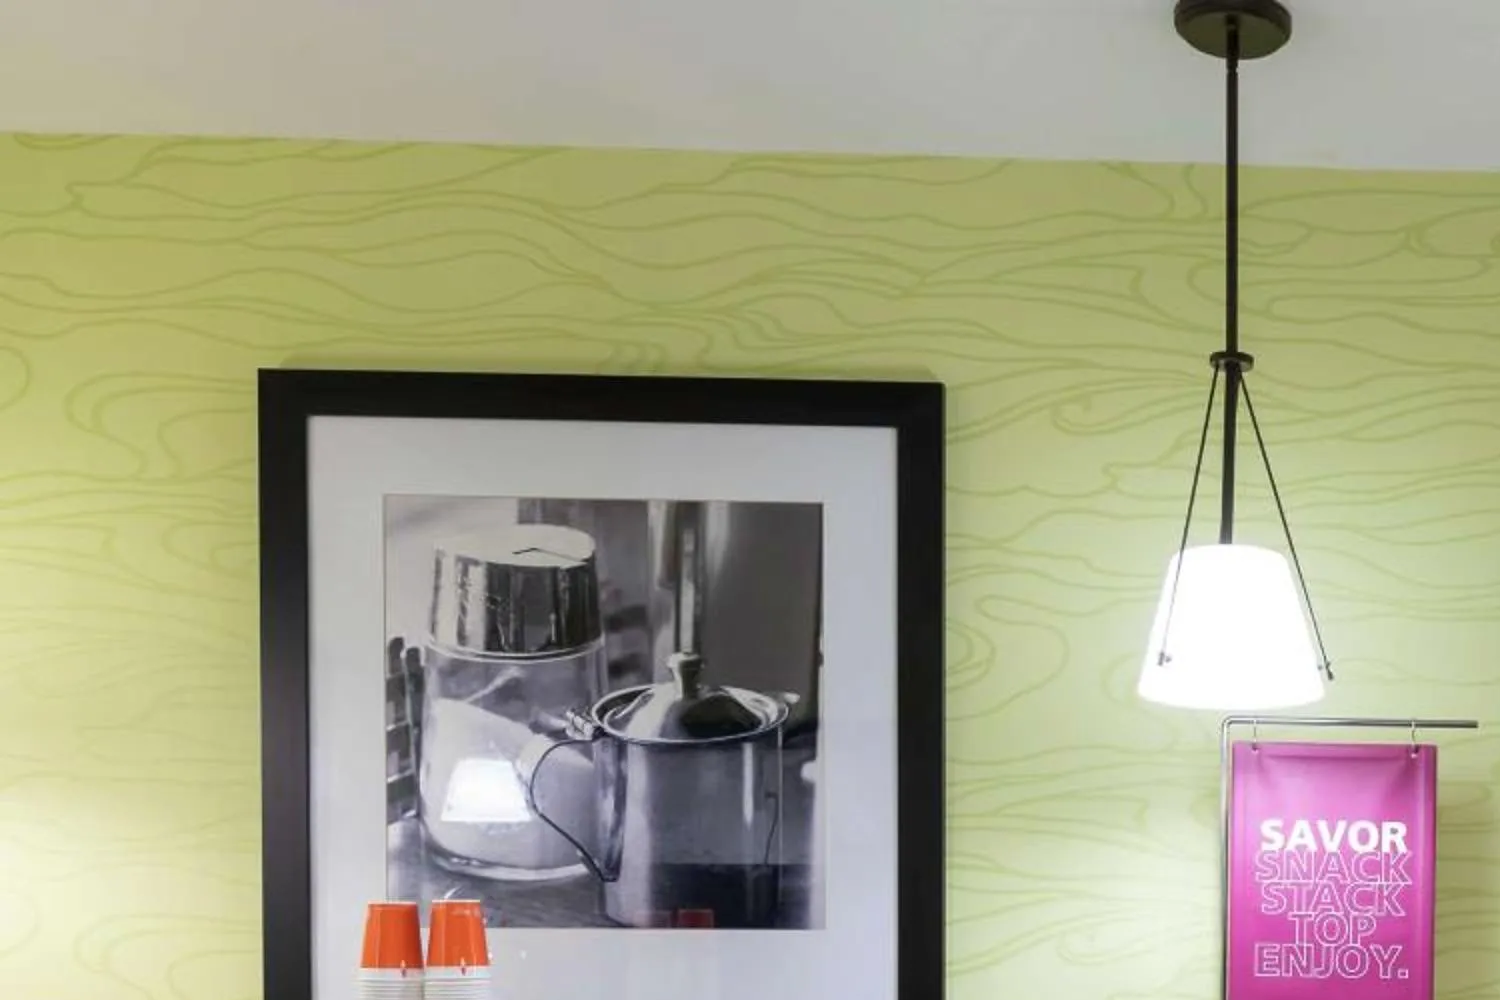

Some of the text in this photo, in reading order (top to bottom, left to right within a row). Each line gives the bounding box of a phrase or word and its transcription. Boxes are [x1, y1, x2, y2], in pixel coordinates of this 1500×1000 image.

[1260, 819, 1407, 852] SAVOR
[1255, 850, 1412, 884] SNACK
[1261, 881, 1406, 916] STACK
[1288, 912, 1377, 946] TOP
[1254, 943, 1409, 979] ENJOY.
